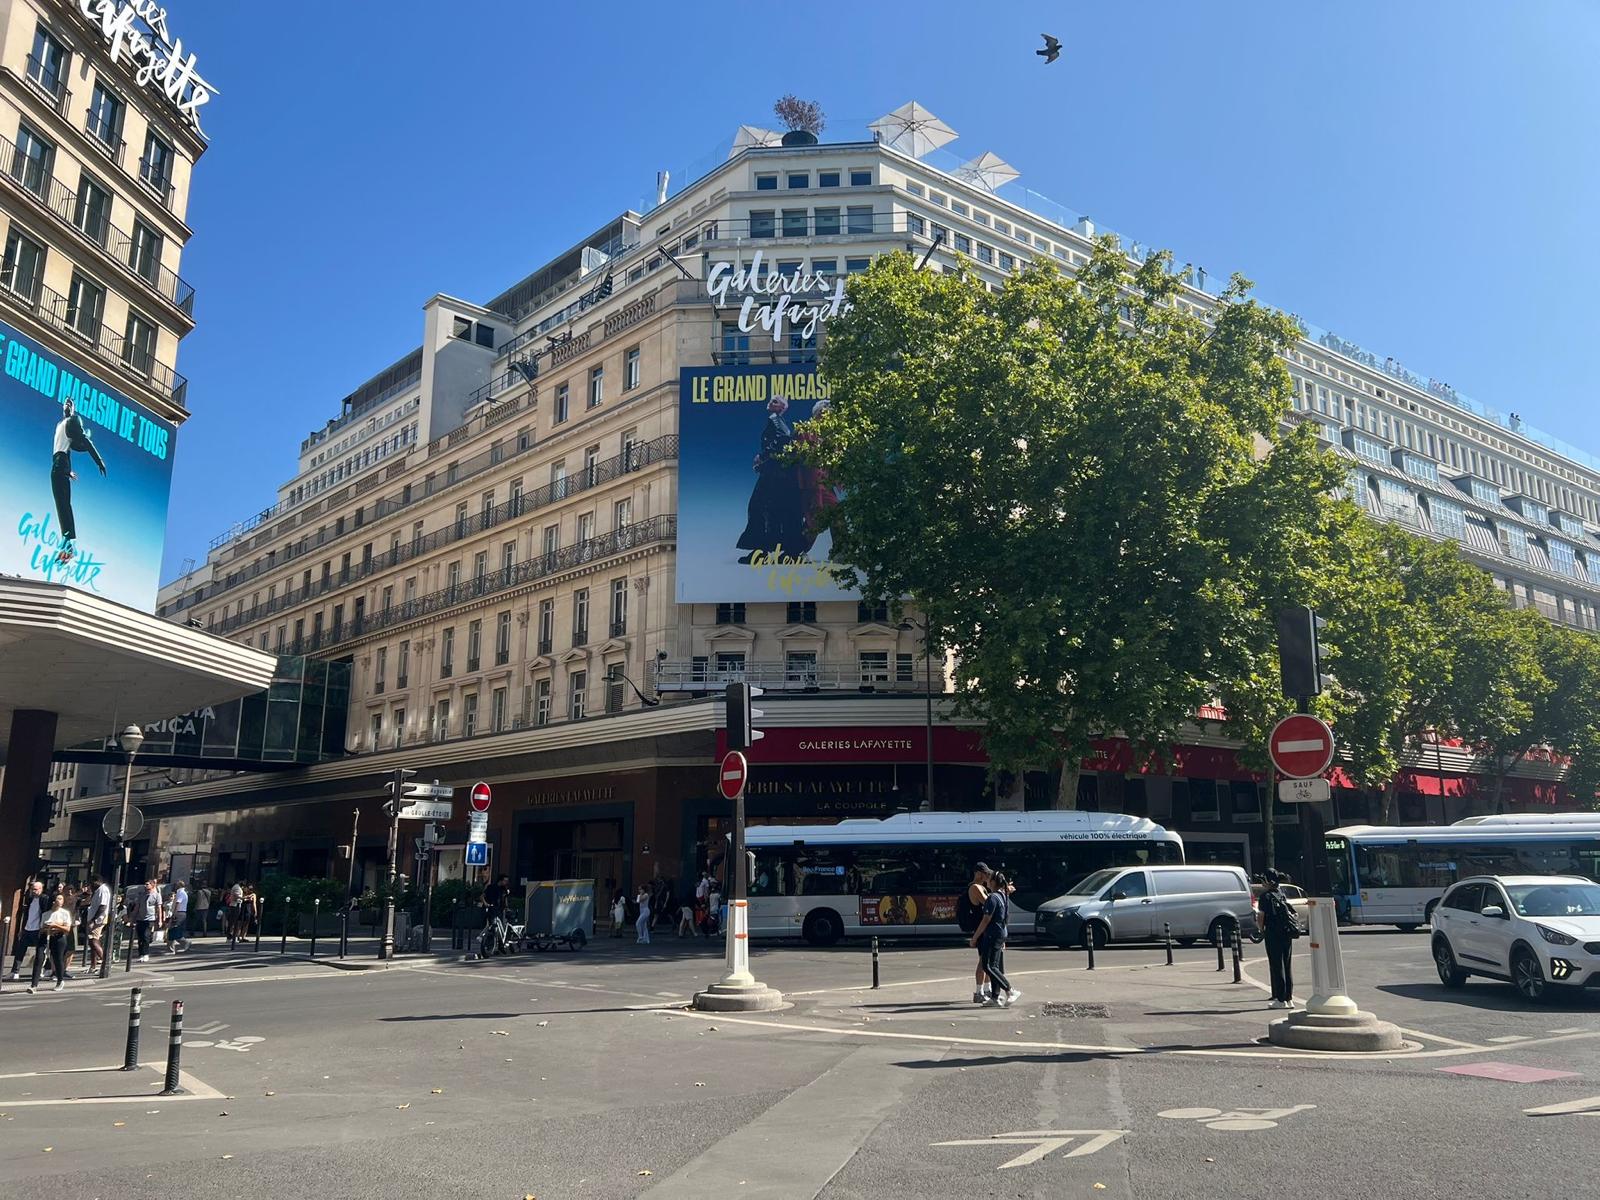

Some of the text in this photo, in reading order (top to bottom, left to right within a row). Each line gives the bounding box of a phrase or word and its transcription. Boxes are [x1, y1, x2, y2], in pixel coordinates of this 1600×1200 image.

[707, 250, 831, 306] Galeries
[5, 340, 58, 398] GRAND
[58, 370, 119, 433] MAGASIN
[119, 406, 137, 443] DE
[138, 415, 168, 461] TOUS
[692, 373, 831, 403] LE GRAND MAGASI
[799, 740, 912, 750] GALERIES LAFAYETTE
[1060, 832, 1147, 841] véhicule 100% électrique
